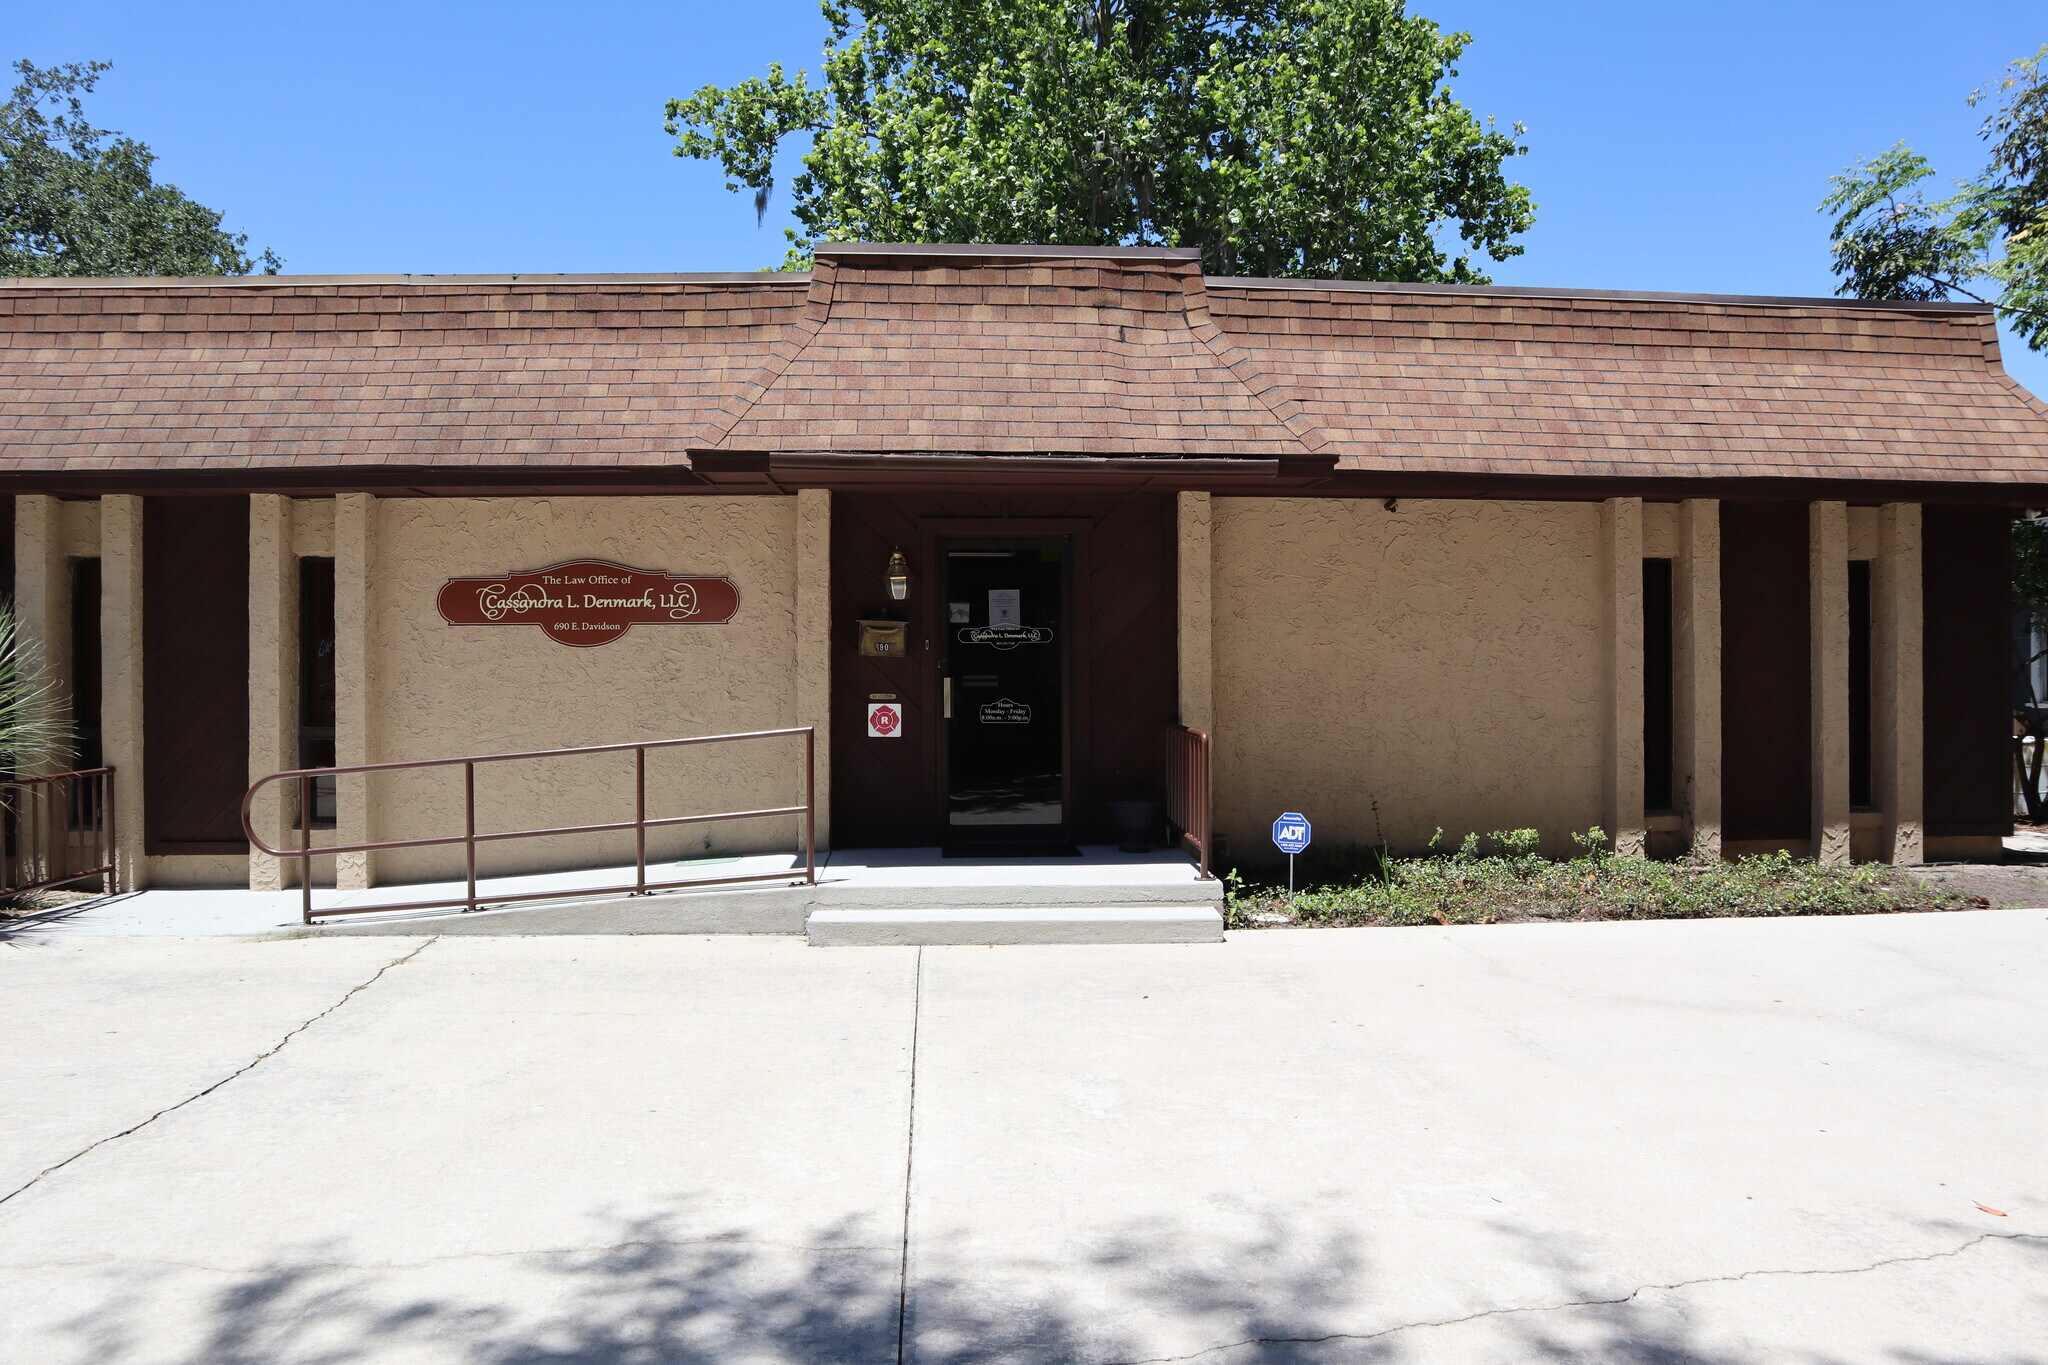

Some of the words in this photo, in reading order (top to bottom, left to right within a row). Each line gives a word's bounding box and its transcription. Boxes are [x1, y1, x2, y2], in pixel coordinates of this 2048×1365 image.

[542, 575, 562, 585] The
[564, 575, 586, 585] Law
[588, 575, 619, 585] Office
[621, 575, 633, 585] of
[476, 583, 564, 621] Cassandra
[566, 594, 580, 609] L.
[583, 588, 656, 610] Denmark,
[659, 582, 701, 620] LLC
[554, 622, 569, 632] 690
[571, 622, 580, 631] E.
[582, 622, 621, 632] Davidson
[881, 716, 889, 725] R
[1279, 826, 1304, 841] ADT
